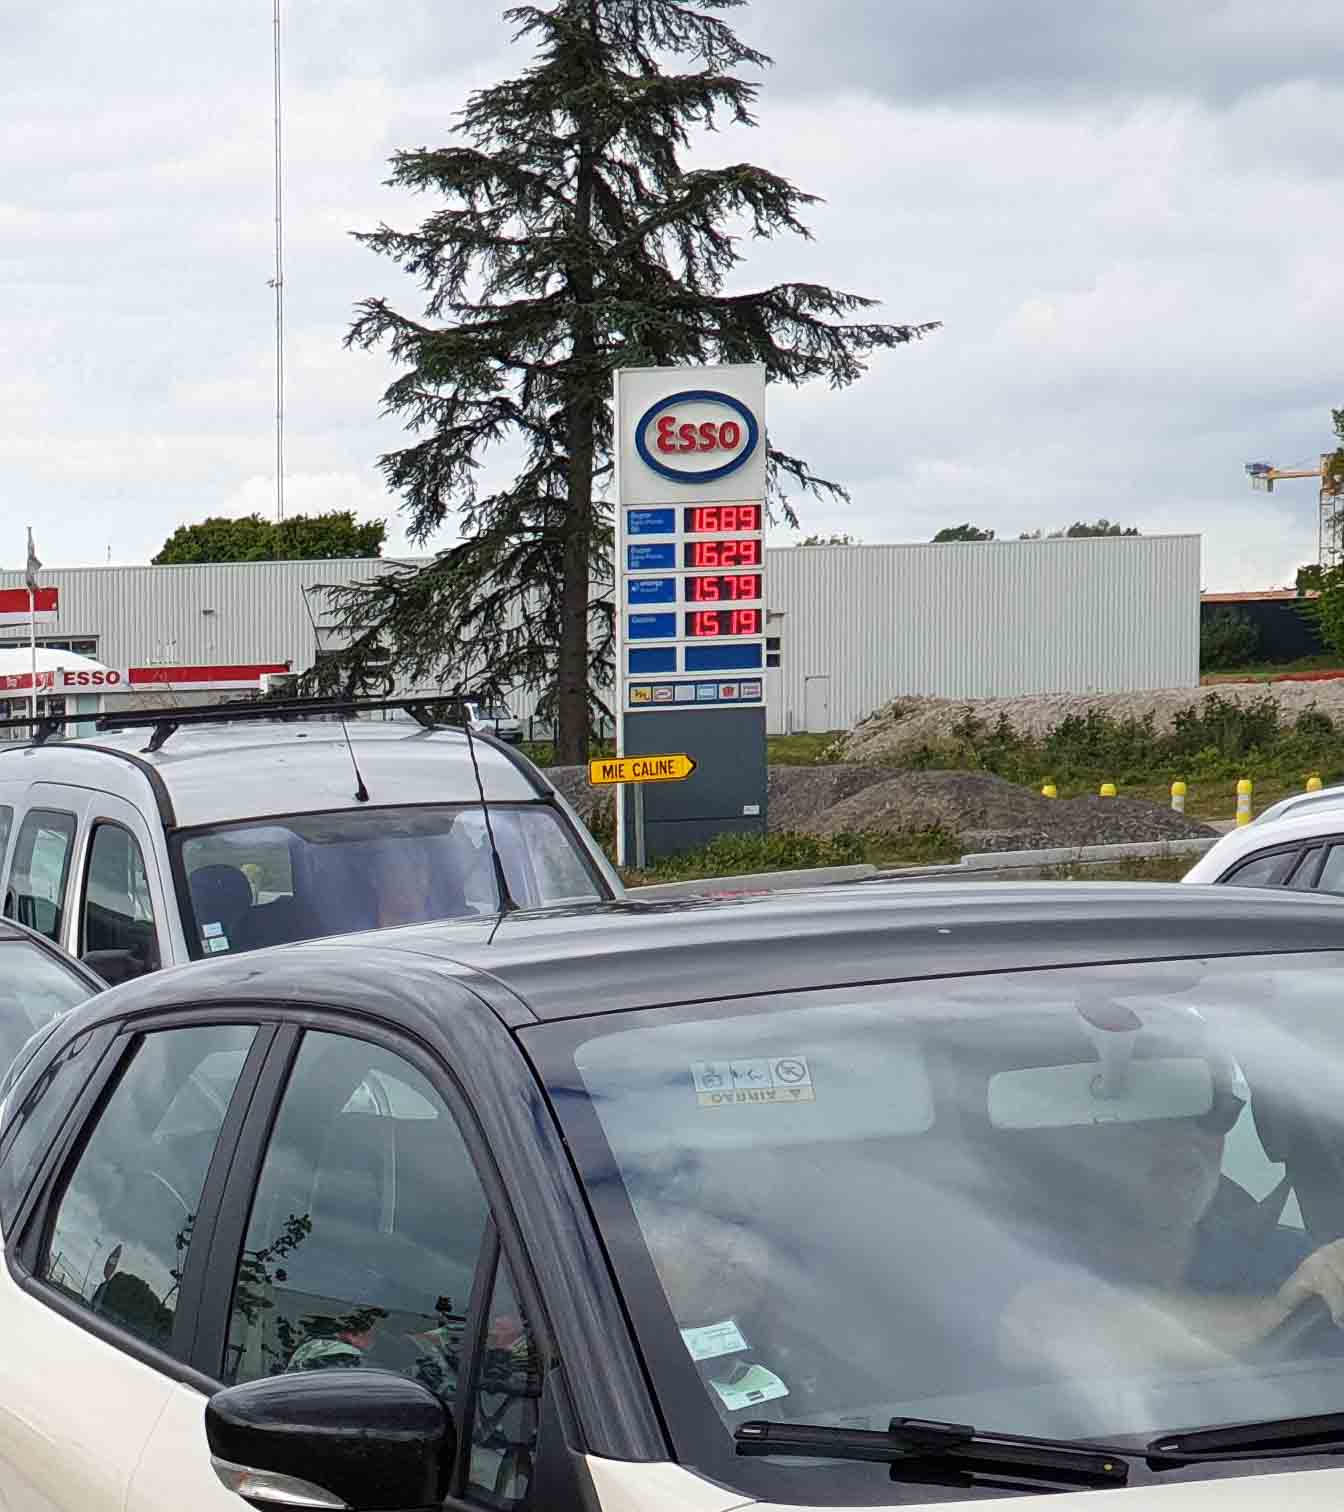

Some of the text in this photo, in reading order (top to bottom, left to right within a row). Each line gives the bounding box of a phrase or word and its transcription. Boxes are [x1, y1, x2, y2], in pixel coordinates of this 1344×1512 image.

[656, 415, 740, 452] Esso
[63, 671, 120, 686] ESSO
[602, 759, 675, 780] MIE CALINE
